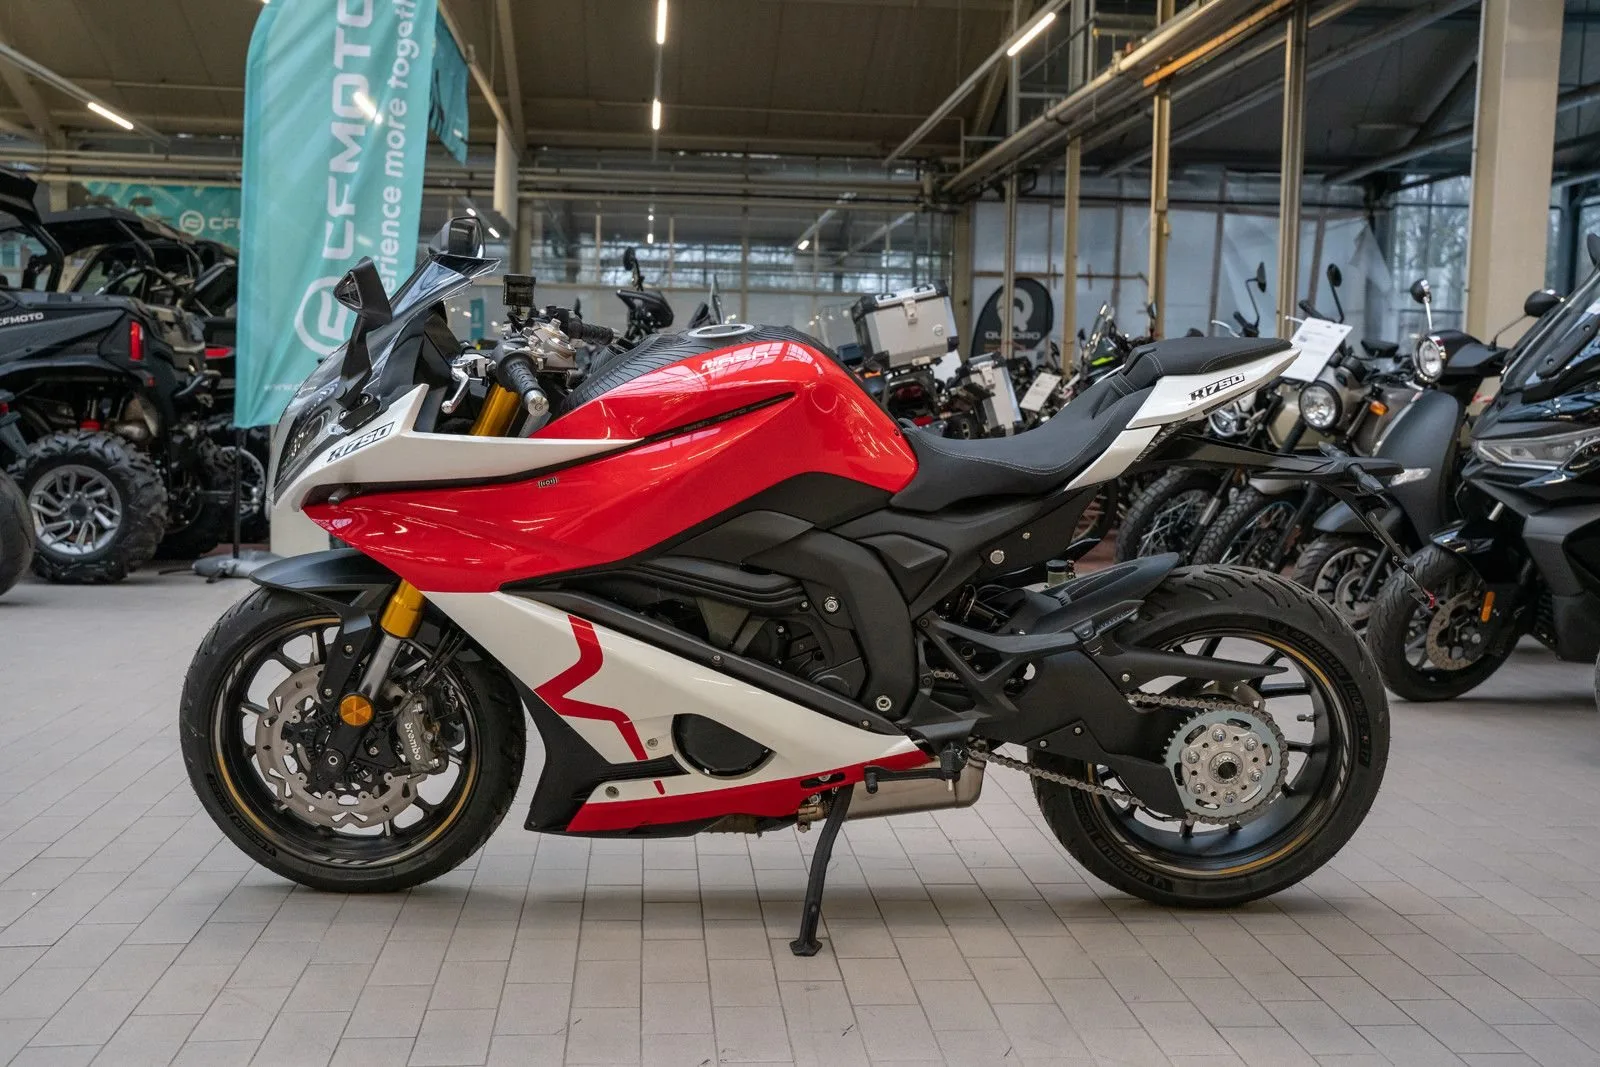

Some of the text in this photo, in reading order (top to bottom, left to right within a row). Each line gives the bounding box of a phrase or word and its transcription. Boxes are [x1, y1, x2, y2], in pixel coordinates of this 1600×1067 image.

[385, 97, 407, 178] more
[374, 186, 402, 298] erience
[985, 331, 1042, 340] QUDRO
[404, 722, 421, 760] brembo
